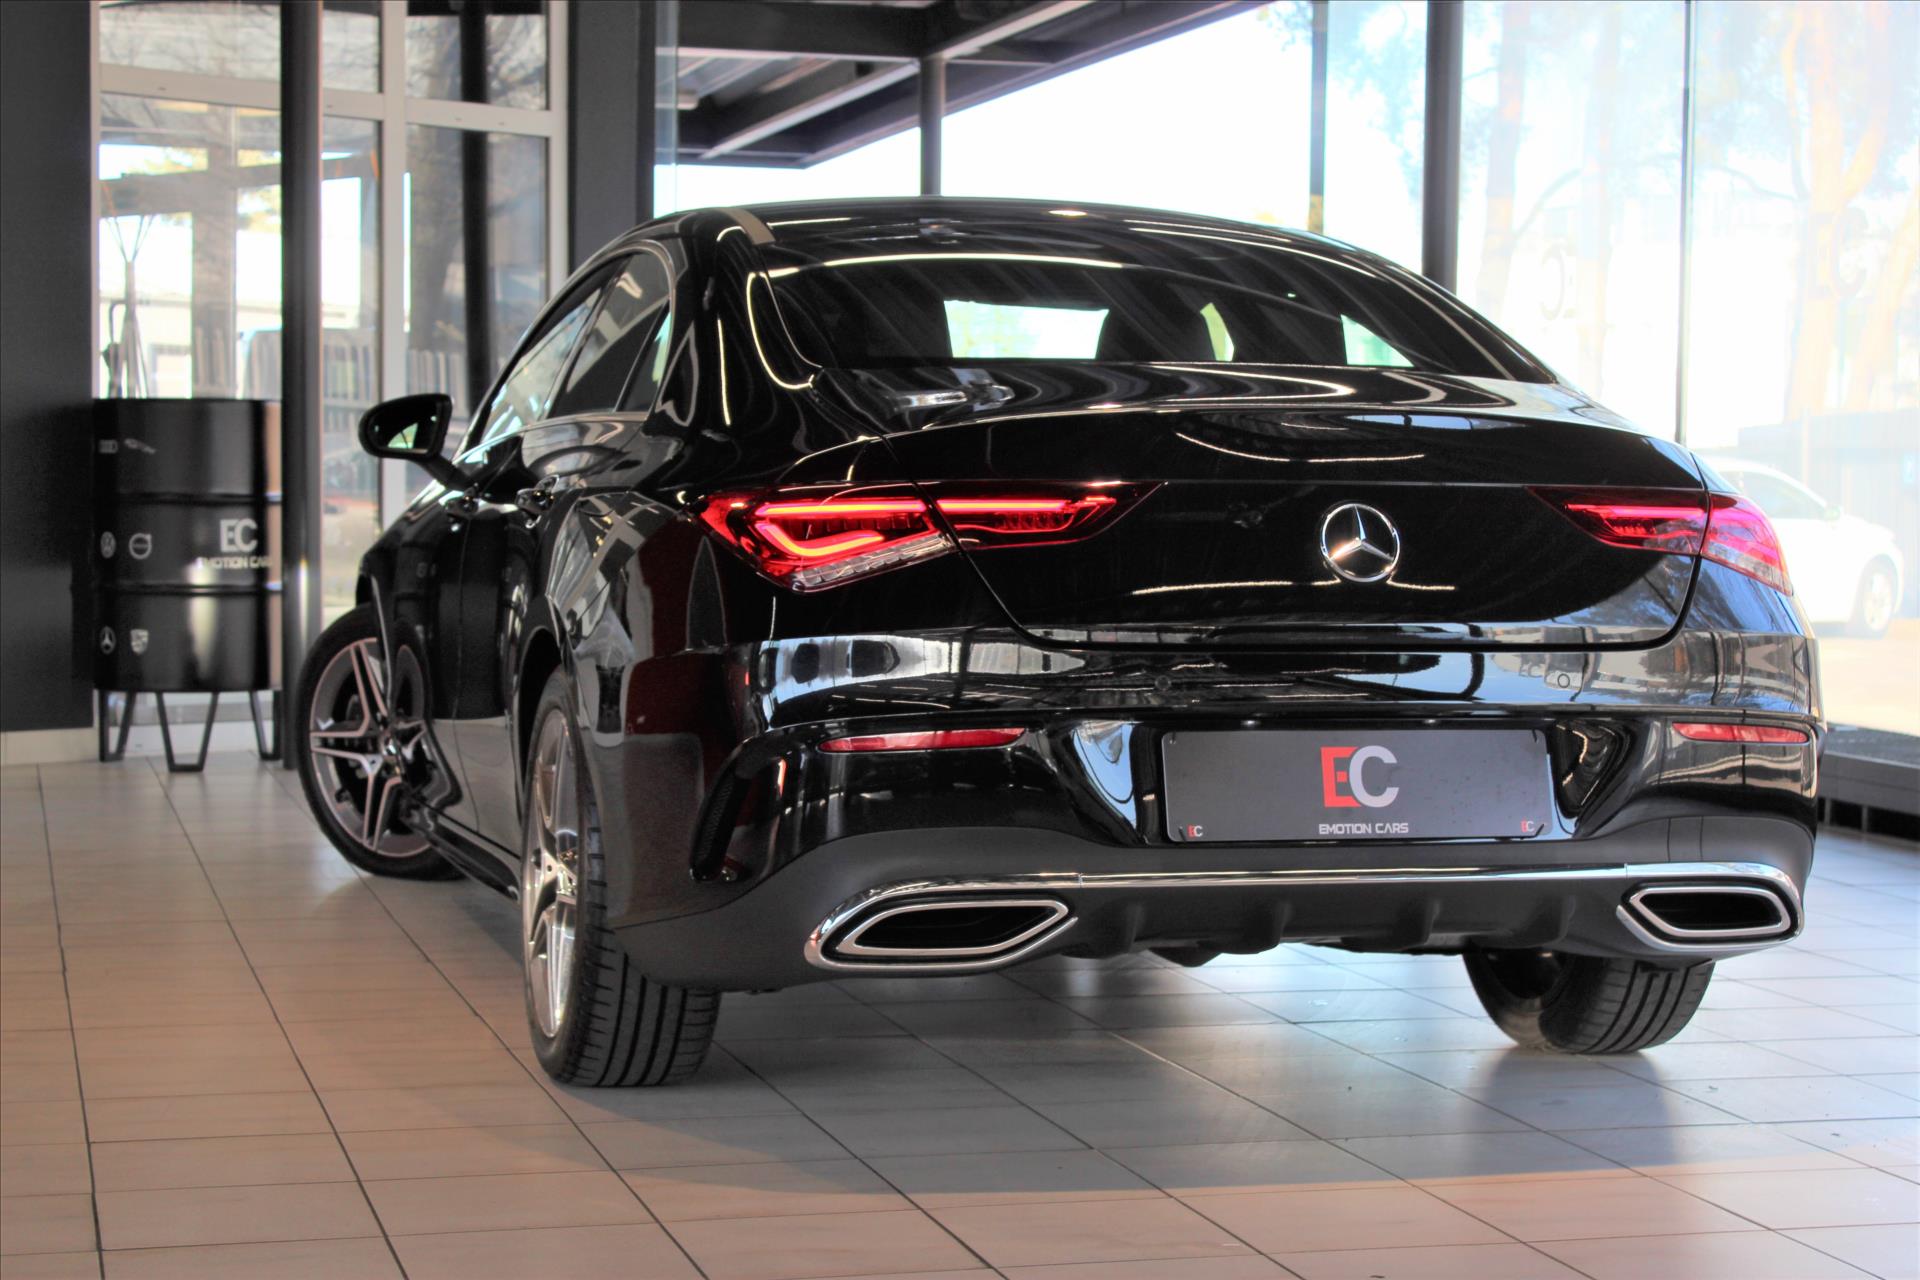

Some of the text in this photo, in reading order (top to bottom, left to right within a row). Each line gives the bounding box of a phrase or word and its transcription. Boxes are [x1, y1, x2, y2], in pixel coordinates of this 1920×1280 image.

[220, 517, 258, 553] EC
[1320, 745, 1399, 808] EC
[1319, 822, 1409, 834] EMOTION CARS
